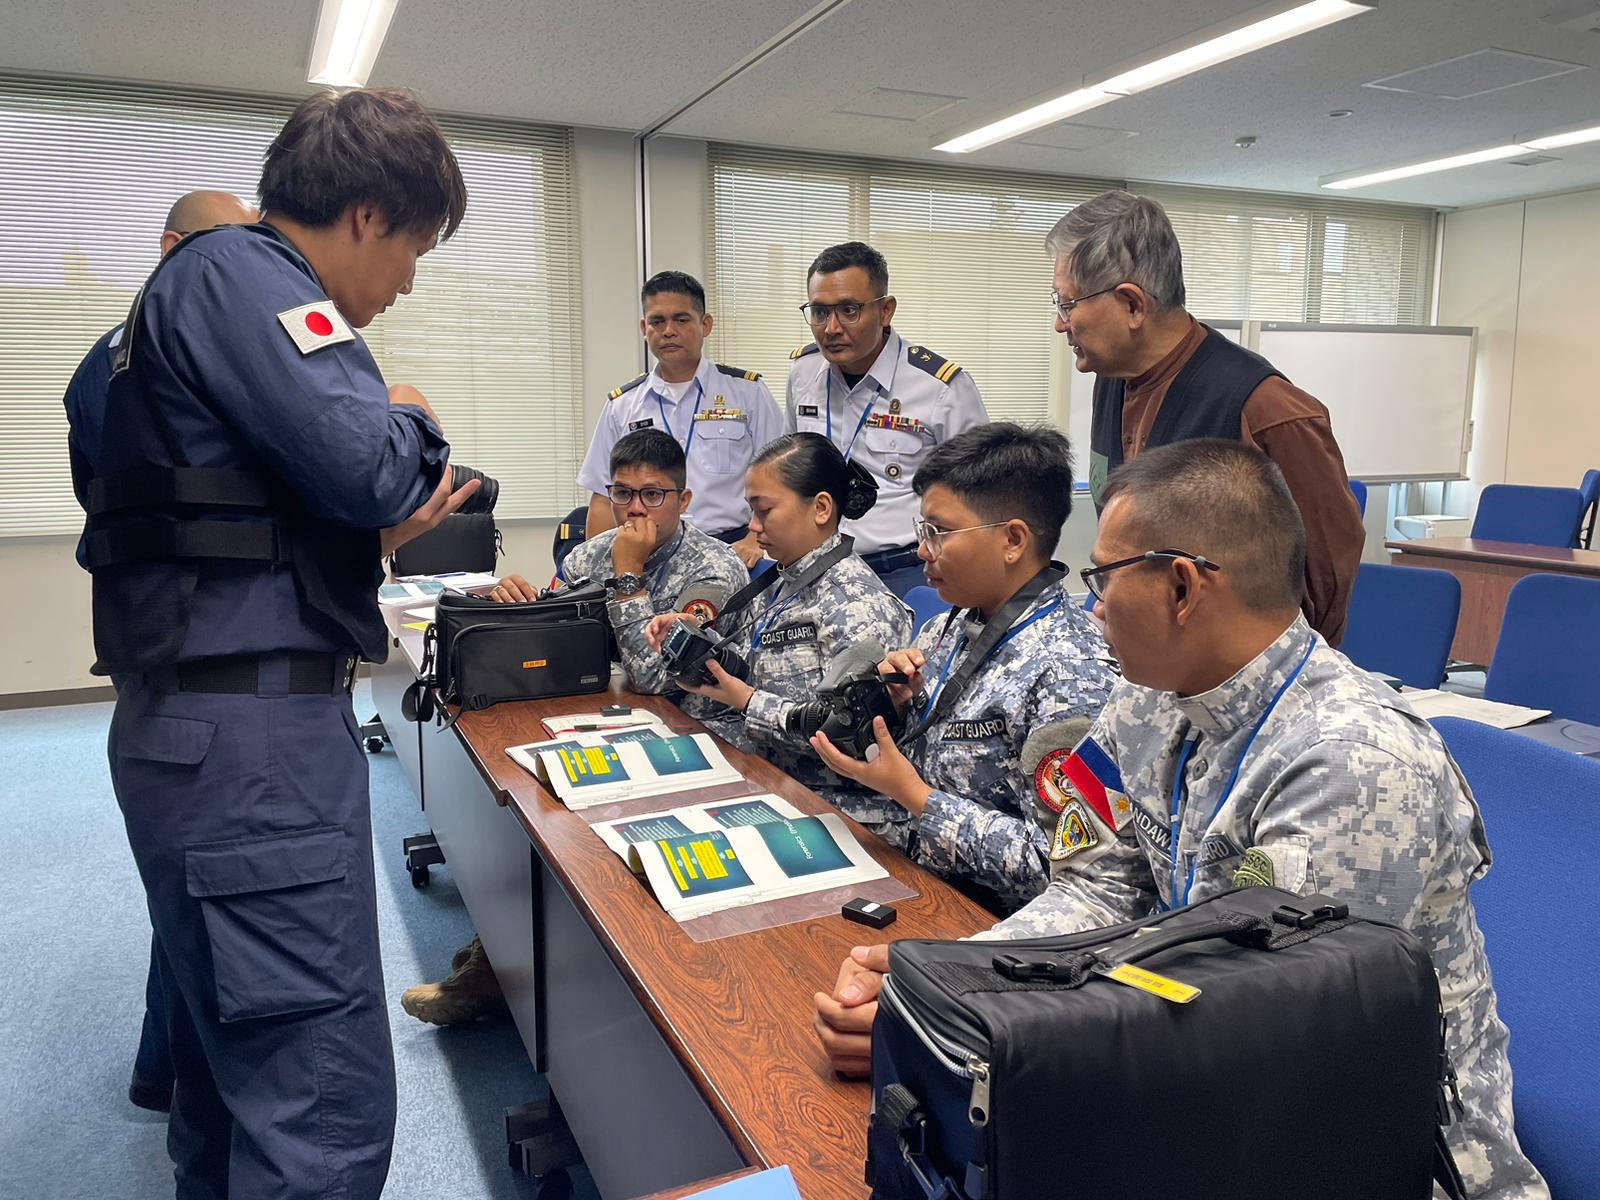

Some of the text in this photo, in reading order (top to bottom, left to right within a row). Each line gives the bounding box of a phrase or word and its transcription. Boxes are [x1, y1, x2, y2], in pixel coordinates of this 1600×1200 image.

[761, 626, 816, 645] COAST GUARD
[966, 719, 1005, 739] GUARD
